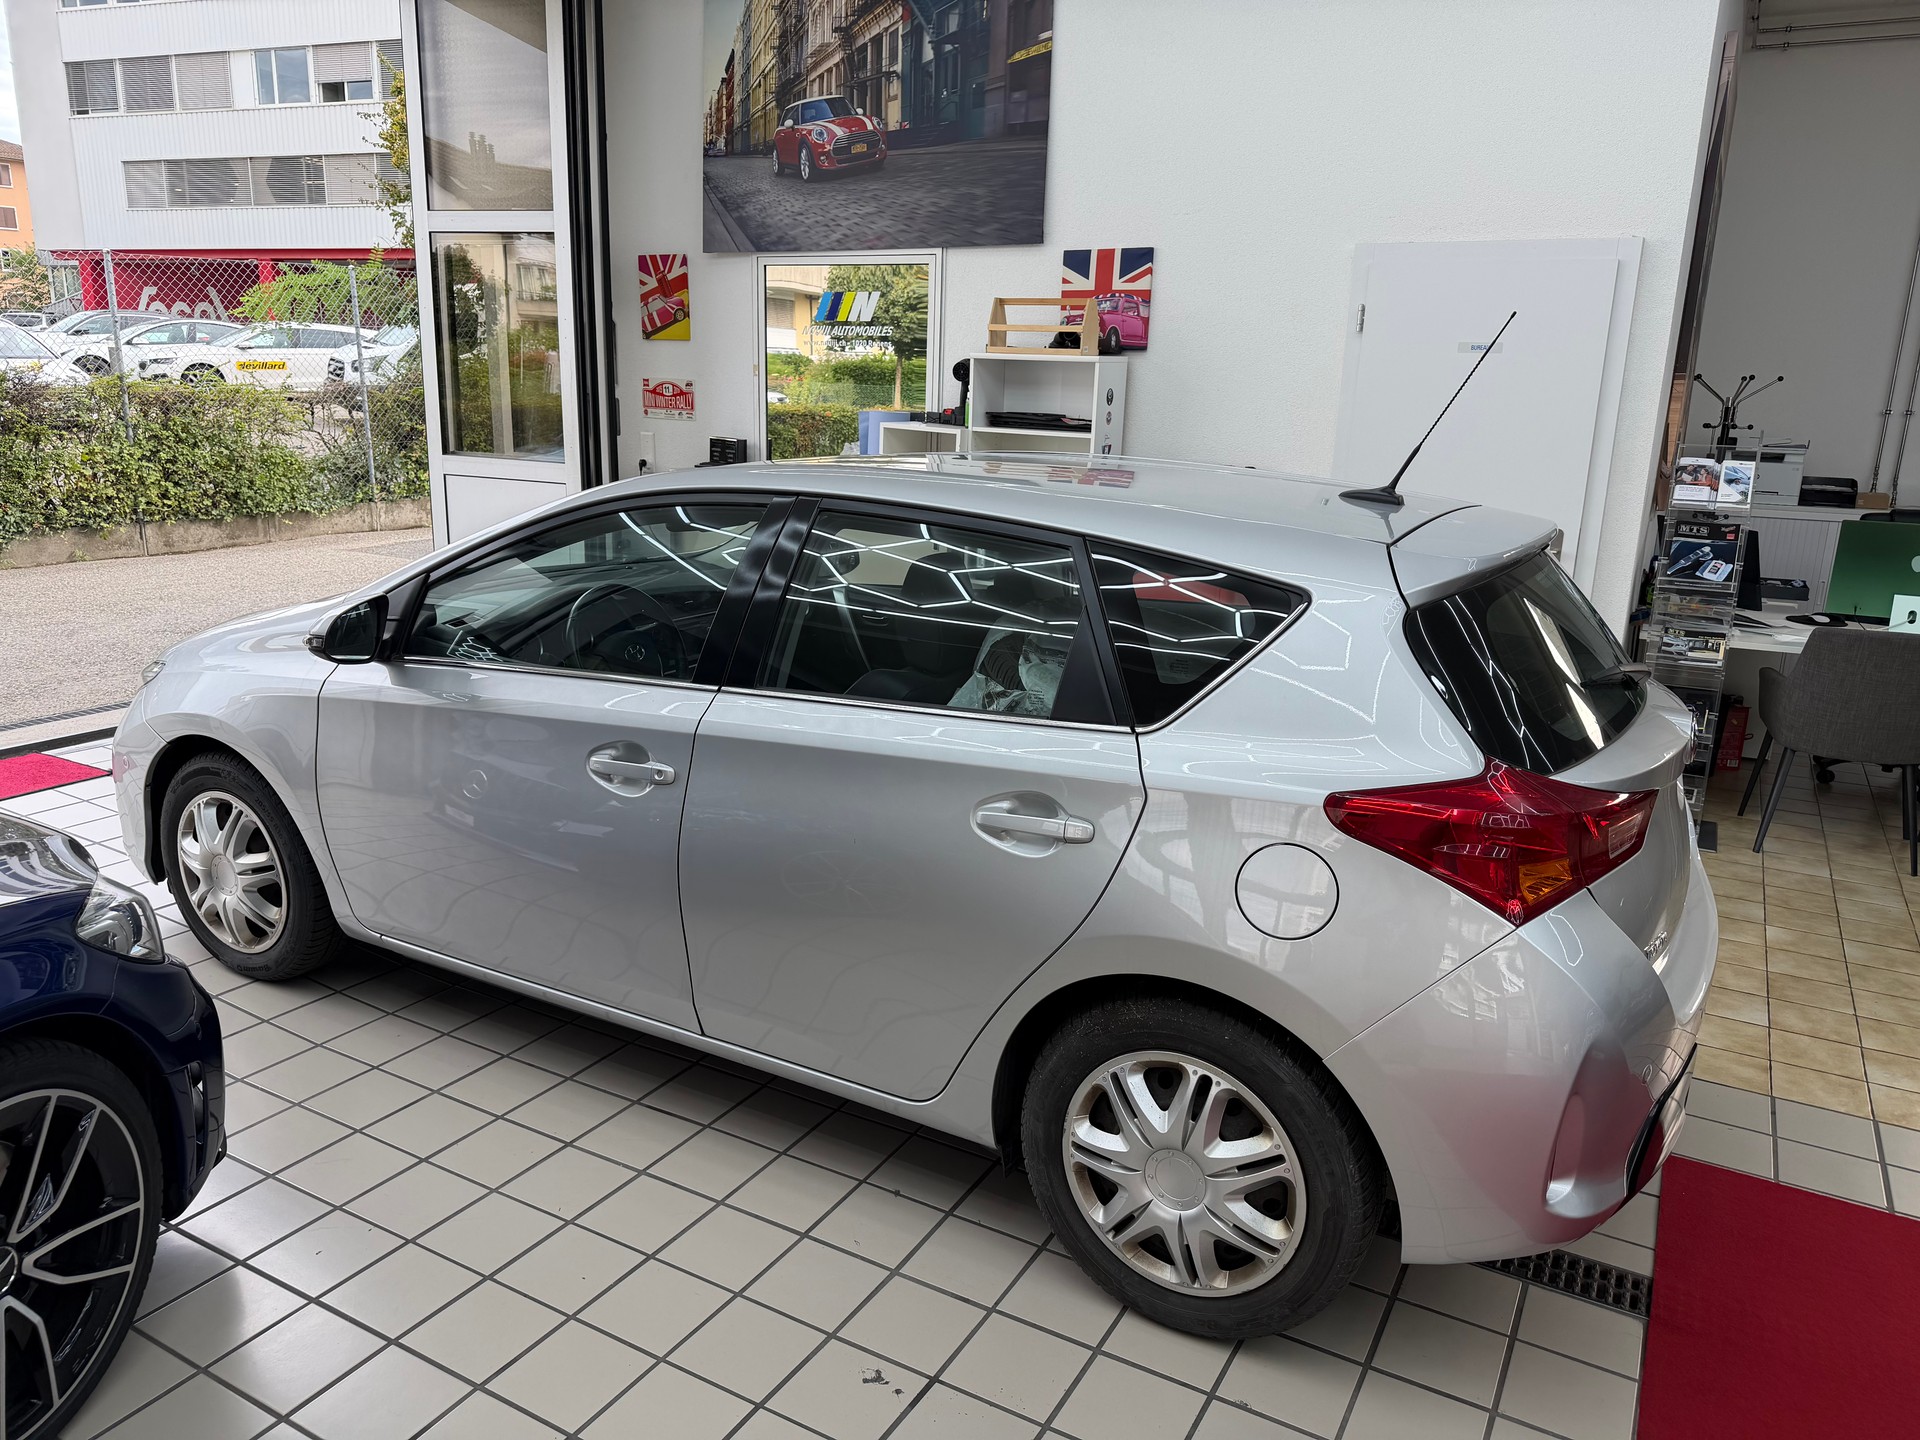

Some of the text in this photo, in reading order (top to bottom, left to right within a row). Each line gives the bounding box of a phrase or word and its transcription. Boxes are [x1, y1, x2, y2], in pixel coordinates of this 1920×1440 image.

[831, 325, 894, 336] AUTOMOBILES
[676, 393, 692, 409] RALLY
[1679, 524, 1708, 534] MTS
